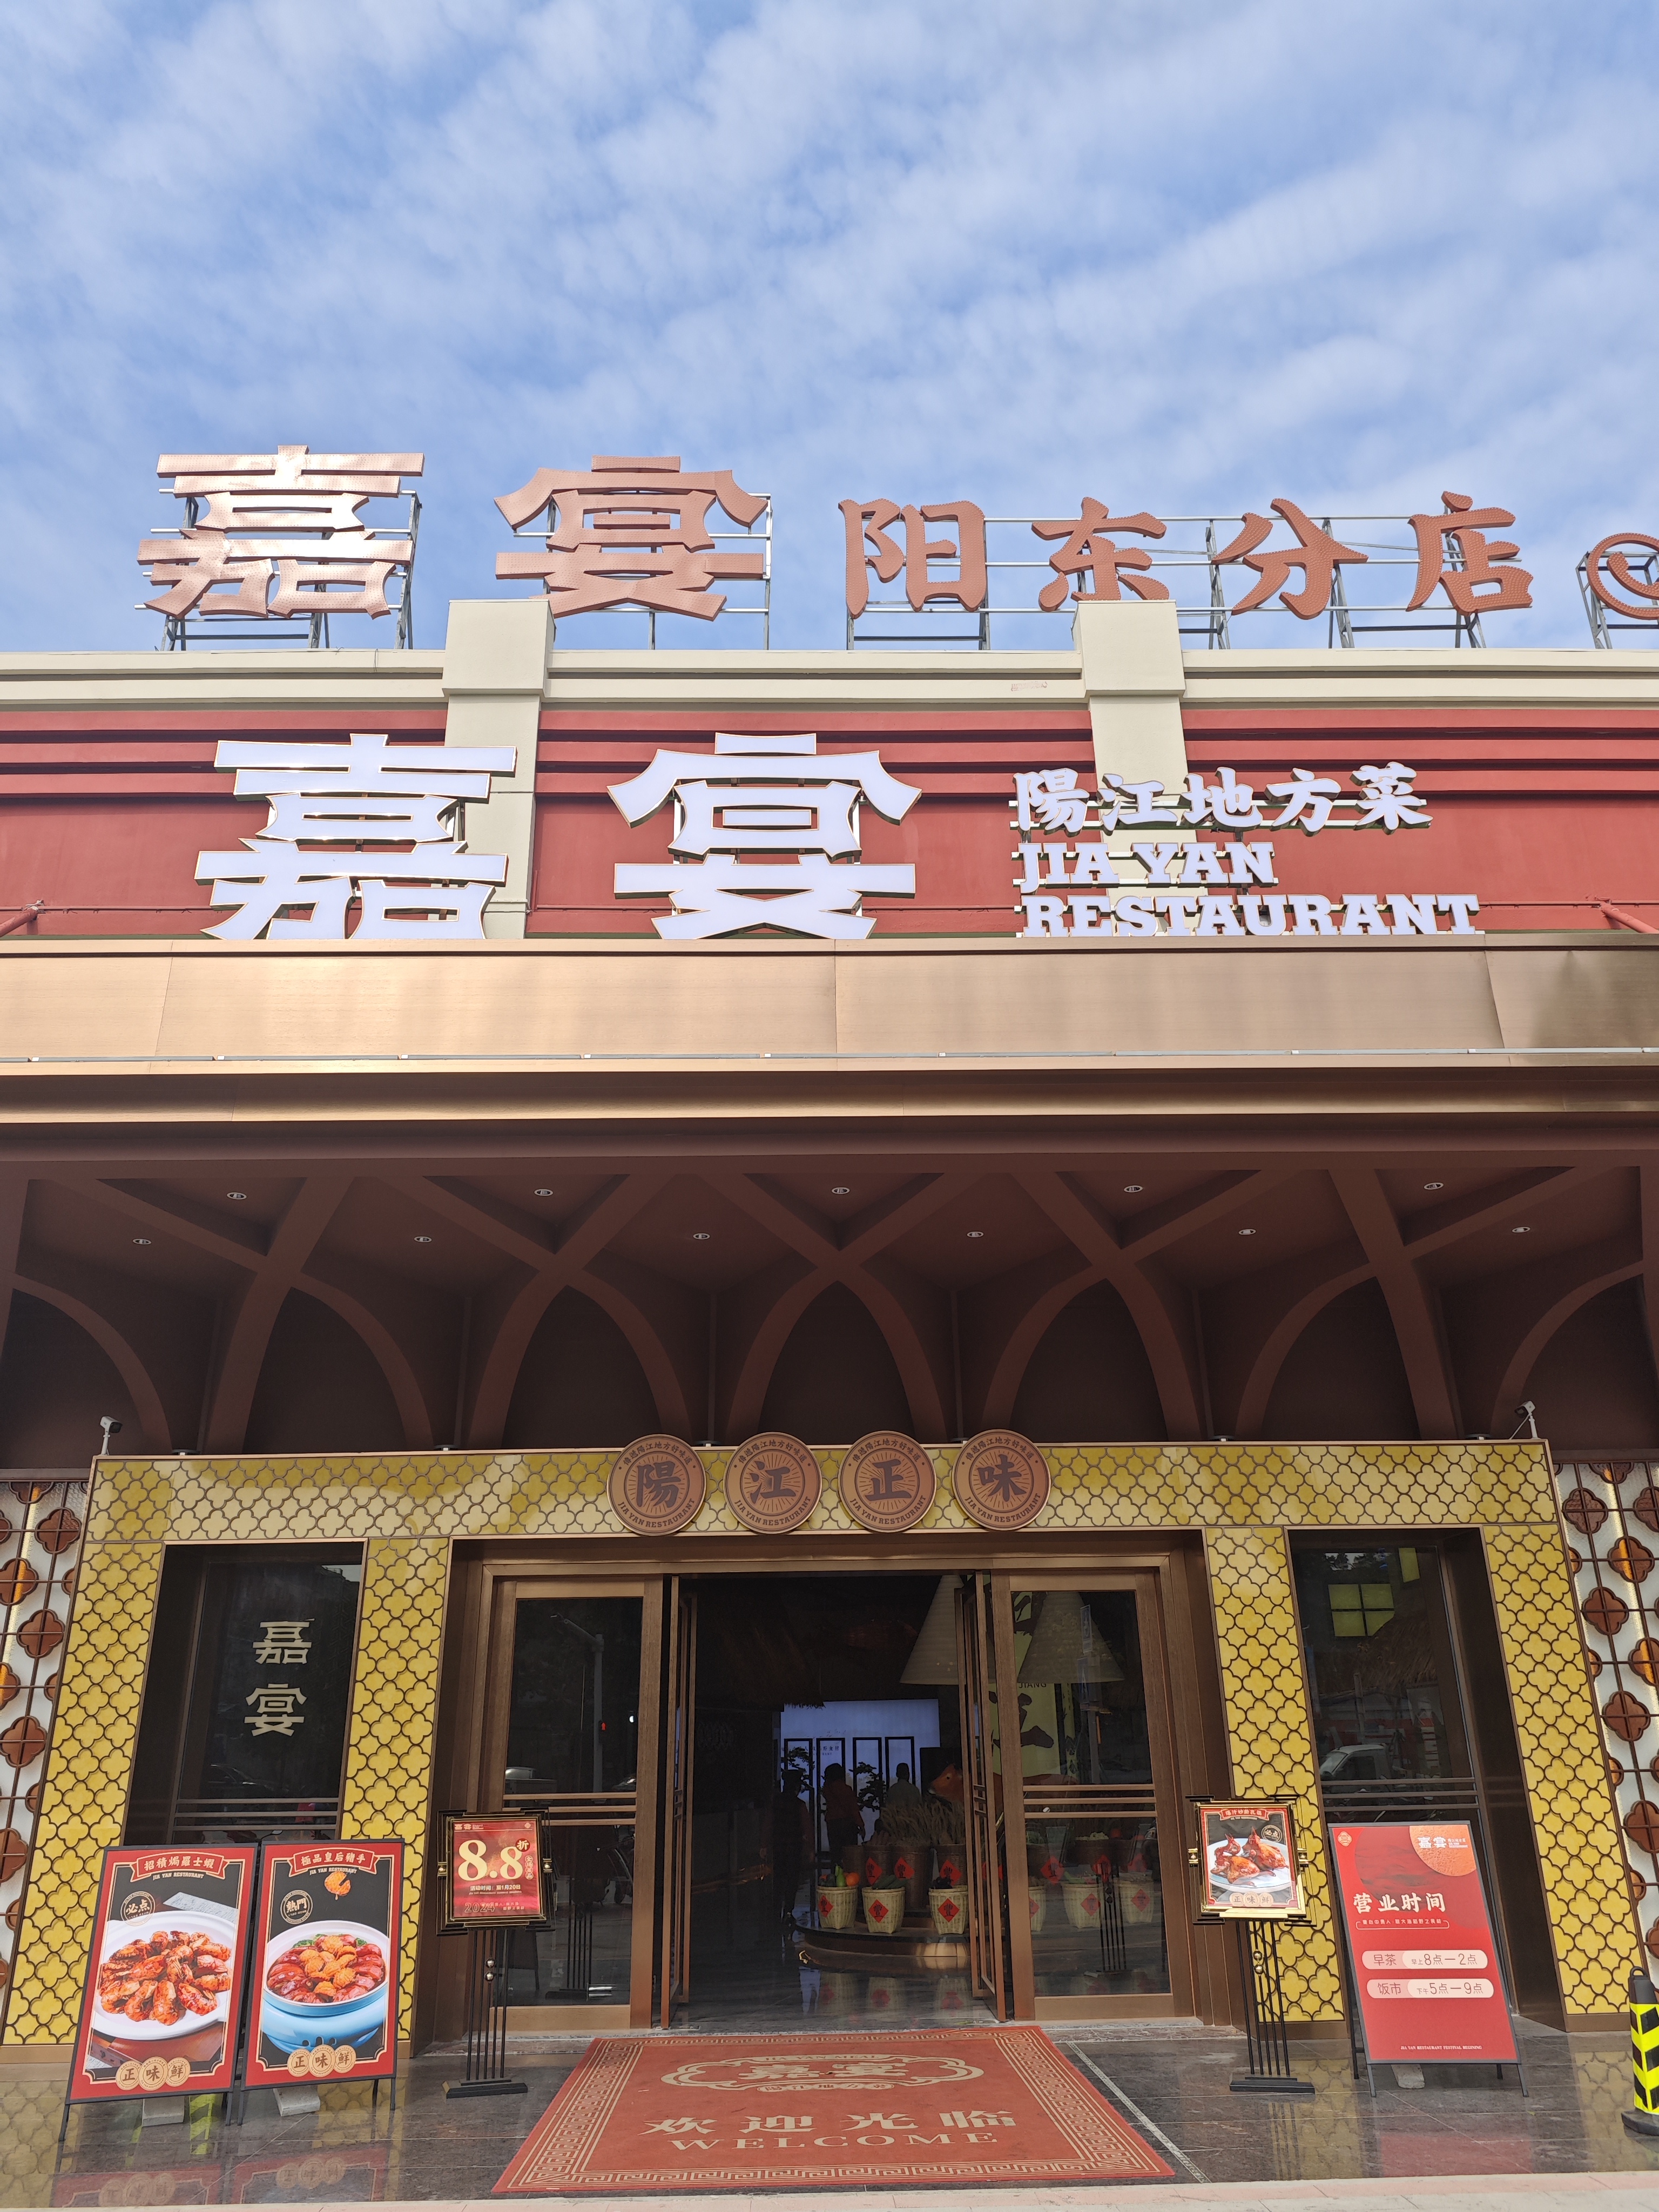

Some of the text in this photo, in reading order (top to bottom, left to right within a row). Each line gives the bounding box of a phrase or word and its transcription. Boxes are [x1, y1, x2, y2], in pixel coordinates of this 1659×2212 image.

[137, 444, 1533, 621] 嘉宴 阳东分店
[1013, 762, 1433, 835] 陽江地方菜
[194, 732, 921, 939] 嘉宴
[1019, 841, 1278, 894] JIA YAN
[1021, 893, 1482, 938] RESTAURANT
[618, 1498, 694, 1528] JIA YAN RESTAURANT
[734, 1496, 811, 1526] JIA YAN RESTAURANT
[850, 1495, 926, 1524] JIA YAN RESTAURANT
[965, 1493, 1041, 1522] JIA YAN RESTAURANT
[517, 1840, 529, 1850] 折
[458, 1839, 523, 1881] 8.8
[126, 1899, 150, 1916] 必点
[286, 1898, 307, 1913] 熱門
[464, 1902, 495, 1913] 2024
[1353, 1892, 1446, 1914] 营业时间
[1373, 1954, 1397, 1966] 早茶
[1378, 1982, 1401, 1995] 饭市
[294, 2052, 349, 2068] 正味鮮
[122, 2065, 184, 2082] 正味鮮
[638, 2110, 1017, 2136] 欢迎光临
[667, 2132, 998, 2151] WELCOME
